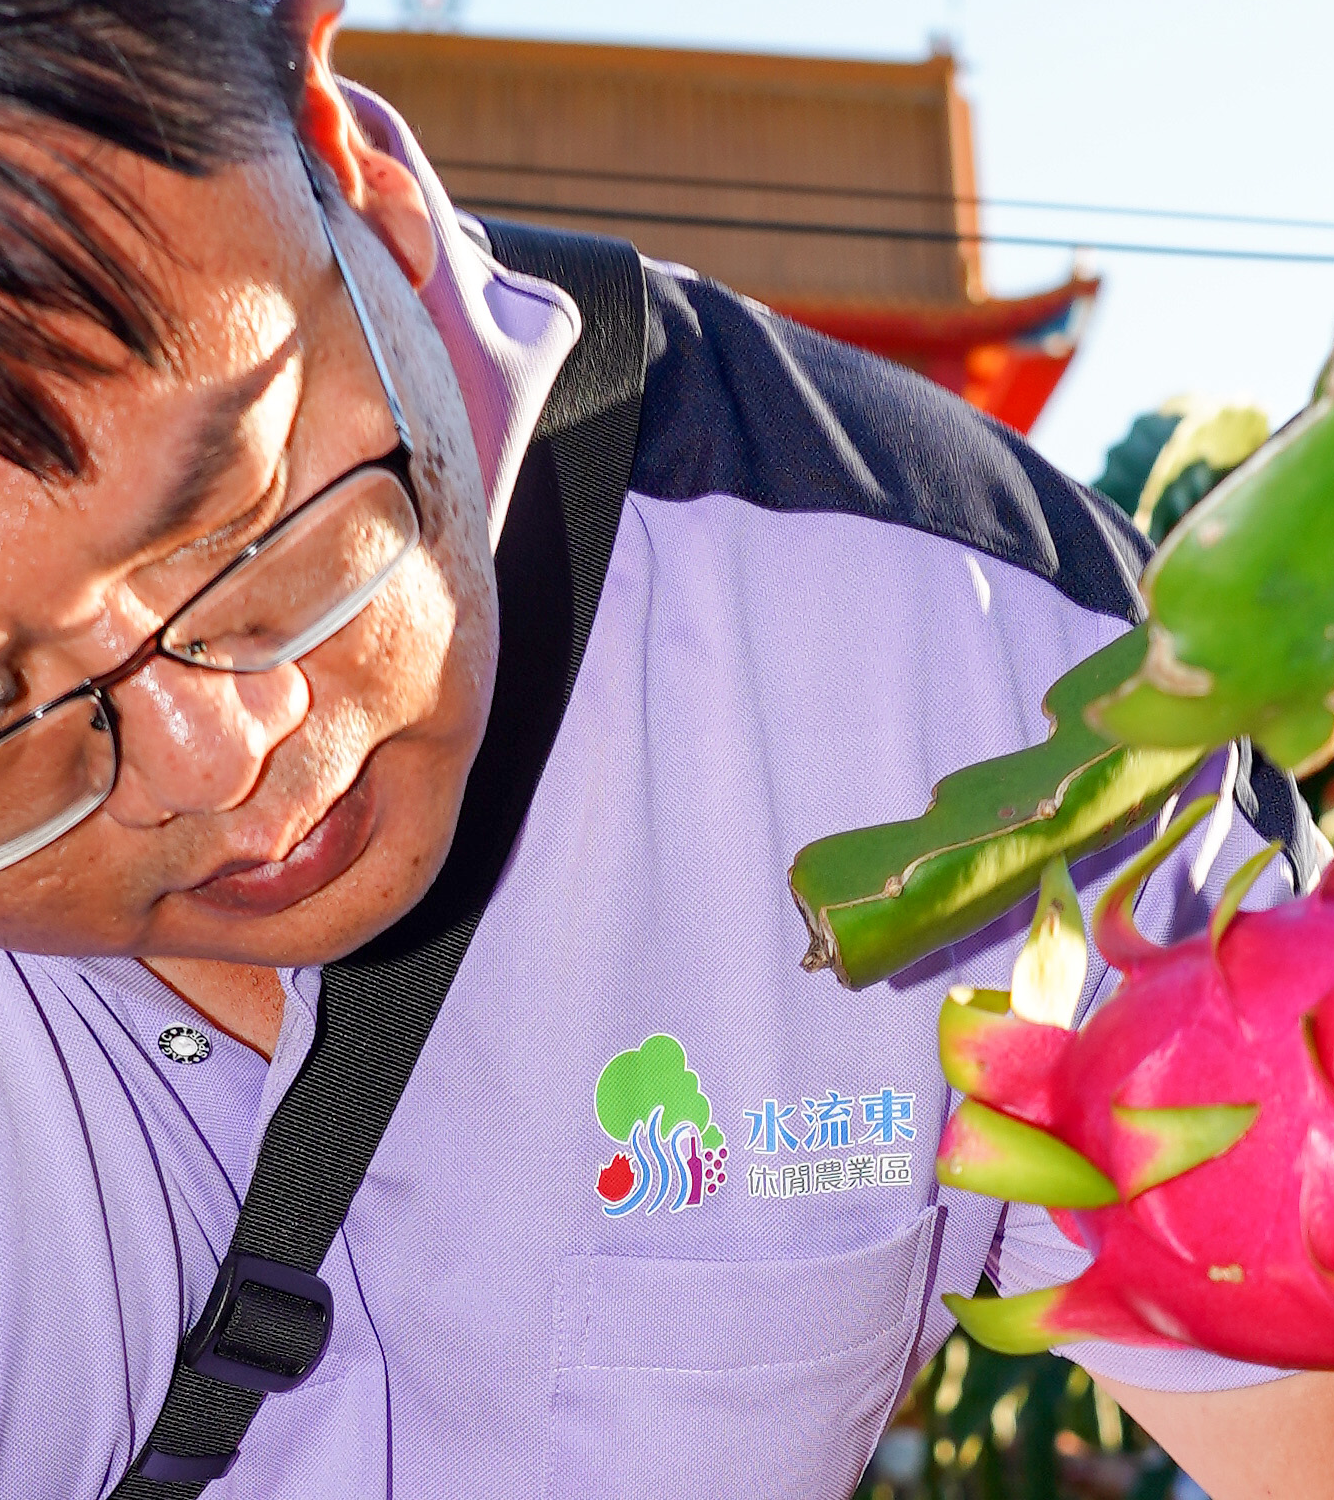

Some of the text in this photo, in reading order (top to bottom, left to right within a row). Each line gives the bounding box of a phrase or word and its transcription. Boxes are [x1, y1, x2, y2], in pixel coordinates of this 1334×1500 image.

[159, 1028, 209, 1064] TAGIC SPORT
[743, 1088, 916, 1153] 水流東
[748, 1155, 911, 1197] 休閒農業區
